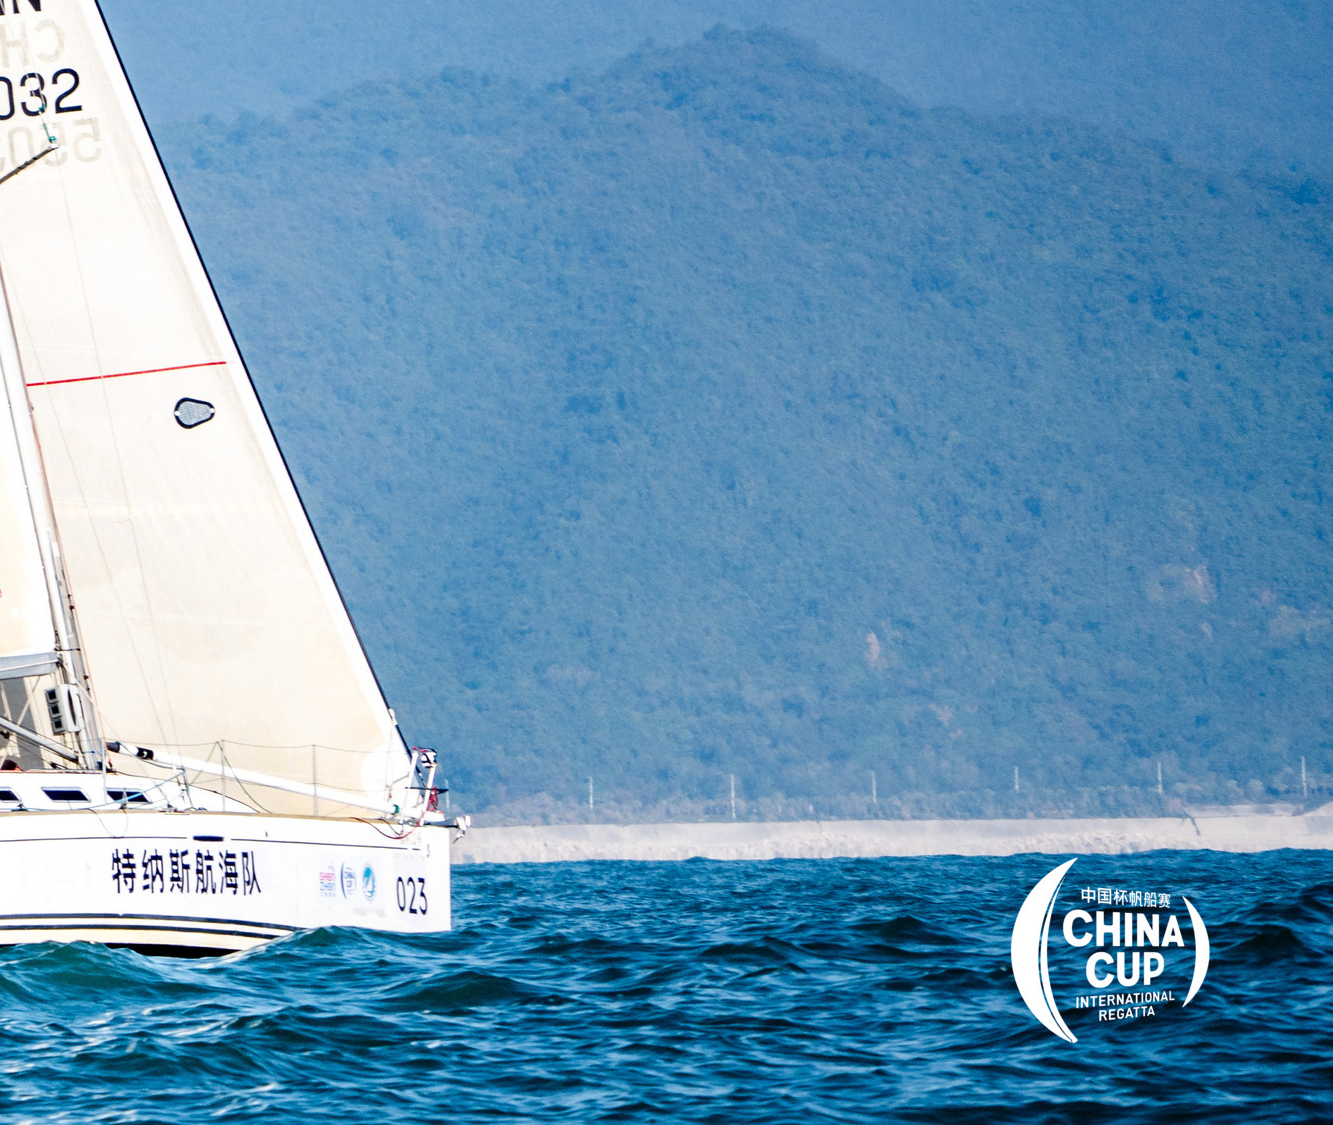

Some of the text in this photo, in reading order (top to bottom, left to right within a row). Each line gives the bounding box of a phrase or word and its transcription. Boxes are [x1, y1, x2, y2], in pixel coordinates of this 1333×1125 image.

[112, 848, 261, 895] 特纳斯航海队
[396, 876, 428, 915] 023
